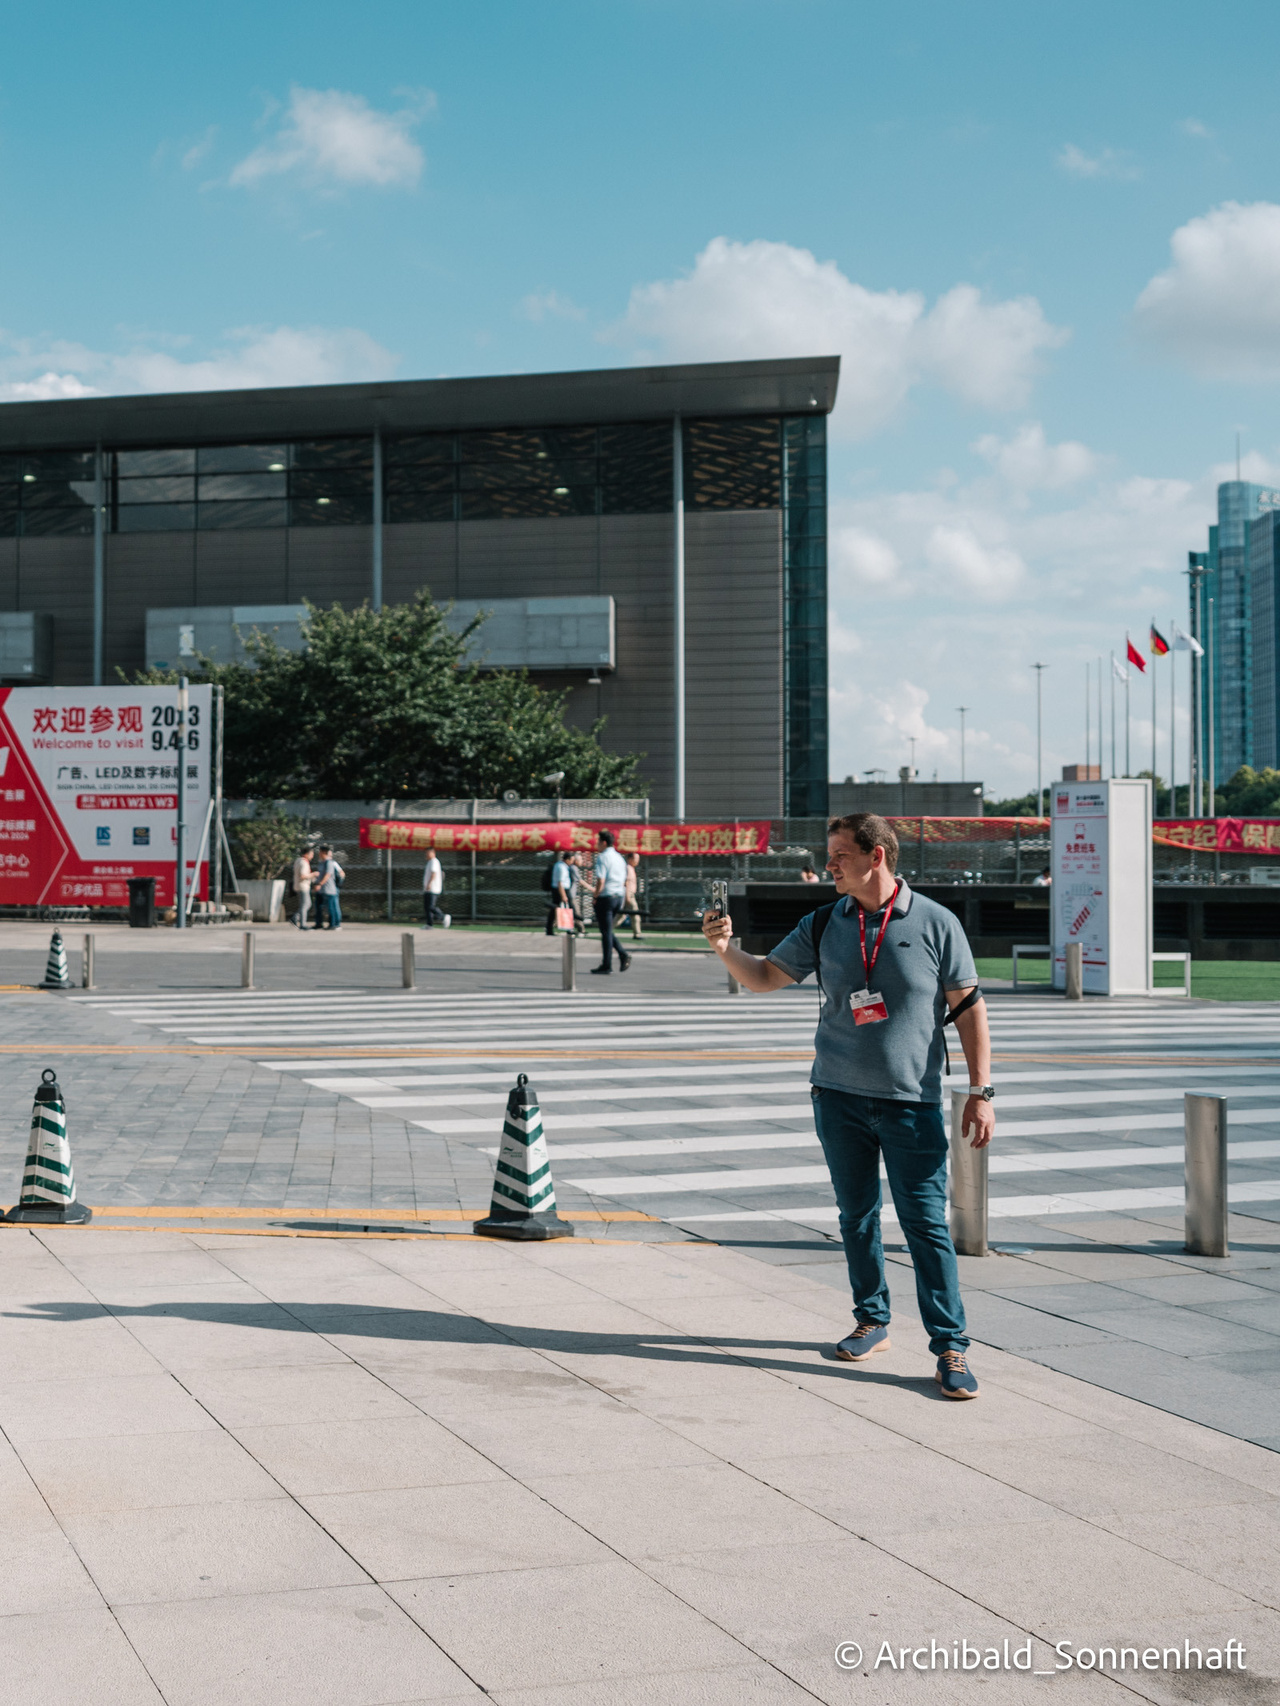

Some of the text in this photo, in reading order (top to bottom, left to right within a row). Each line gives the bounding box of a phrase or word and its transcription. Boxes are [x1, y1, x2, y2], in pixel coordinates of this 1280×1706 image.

[32, 706, 144, 734] 欢迎参观
[152, 705, 200, 727] 203
[32, 738, 144, 749] Welcome to visit
[152, 730, 200, 751] 9.46
